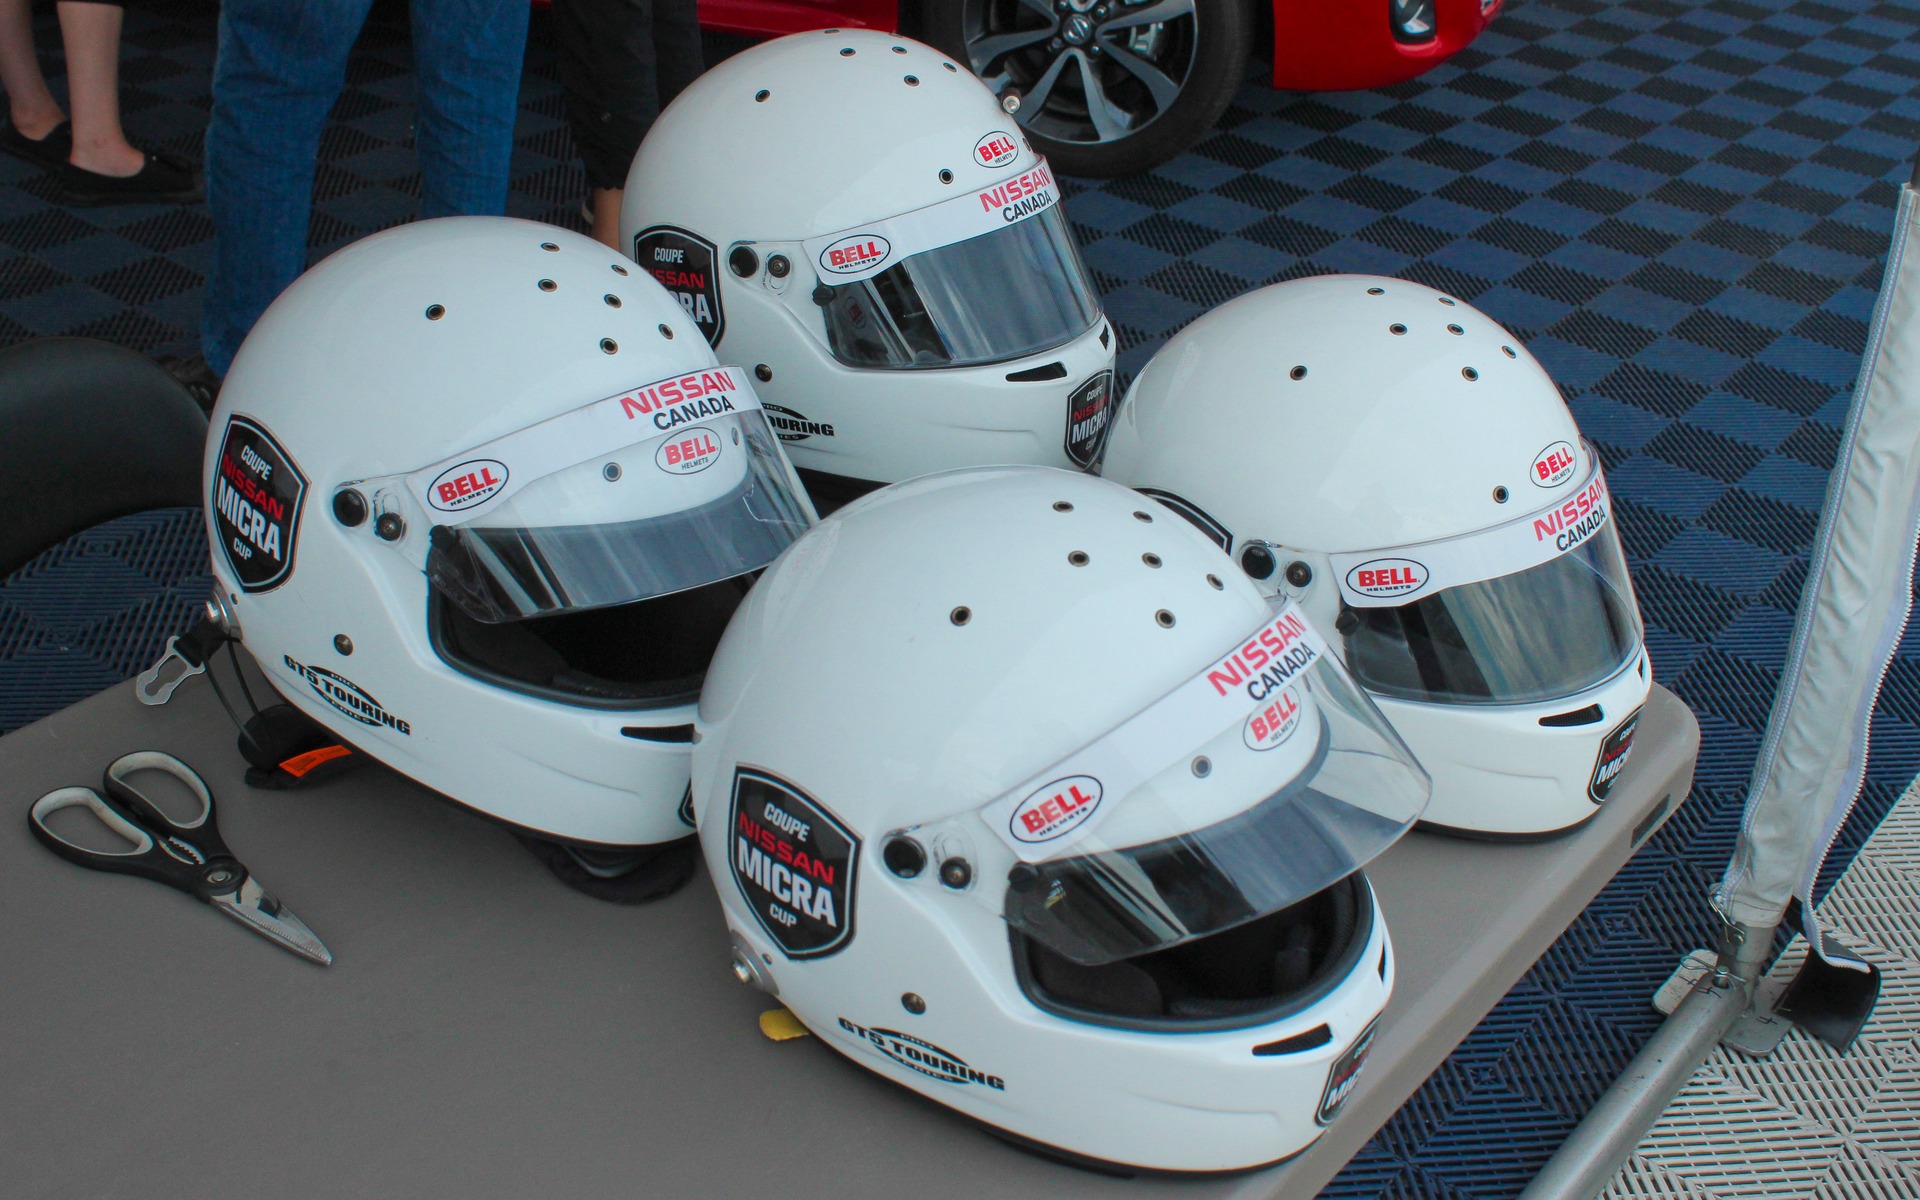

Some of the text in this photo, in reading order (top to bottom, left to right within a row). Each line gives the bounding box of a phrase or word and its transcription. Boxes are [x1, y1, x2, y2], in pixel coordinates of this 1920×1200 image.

[978, 137, 1015, 162] BELL
[980, 167, 1051, 213] NISSAN
[1003, 190, 1053, 222] CANADA
[654, 247, 684, 263] COUPE
[829, 242, 881, 266] BELL
[839, 258, 877, 270] HELMETS
[620, 371, 736, 420] NISSAN
[653, 395, 735, 430] CANADA
[767, 415, 835, 436] OURING
[1072, 407, 1107, 444] MICRA
[241, 445, 272, 481] COUPE
[665, 434, 717, 466] BELL
[681, 457, 709, 470] HELMETS
[1535, 447, 1573, 480] BELL
[222, 453, 284, 520] NISSAN
[437, 467, 498, 503] BELL
[450, 487, 494, 506] HELMETS
[217, 475, 281, 561] MICRA
[1533, 474, 1604, 541] NISSAN
[1556, 505, 1606, 552] CANADA
[233, 537, 252, 560] CUP
[1358, 567, 1418, 587] BELL
[1366, 584, 1411, 592] HELMETS
[1207, 611, 1307, 697] NISSAN
[1247, 642, 1316, 701] CANADA
[284, 654, 411, 735] GT5 TOURING
[1250, 692, 1297, 742] BELL
[764, 802, 810, 842] COUPE
[1020, 785, 1092, 834] BELL
[1039, 806, 1088, 836] HELMETS
[739, 811, 835, 885] NISSAN
[738, 835, 837, 928] MICRA
[770, 902, 797, 928] CUP
[838, 1017, 1005, 1091] GT5 TOURING
